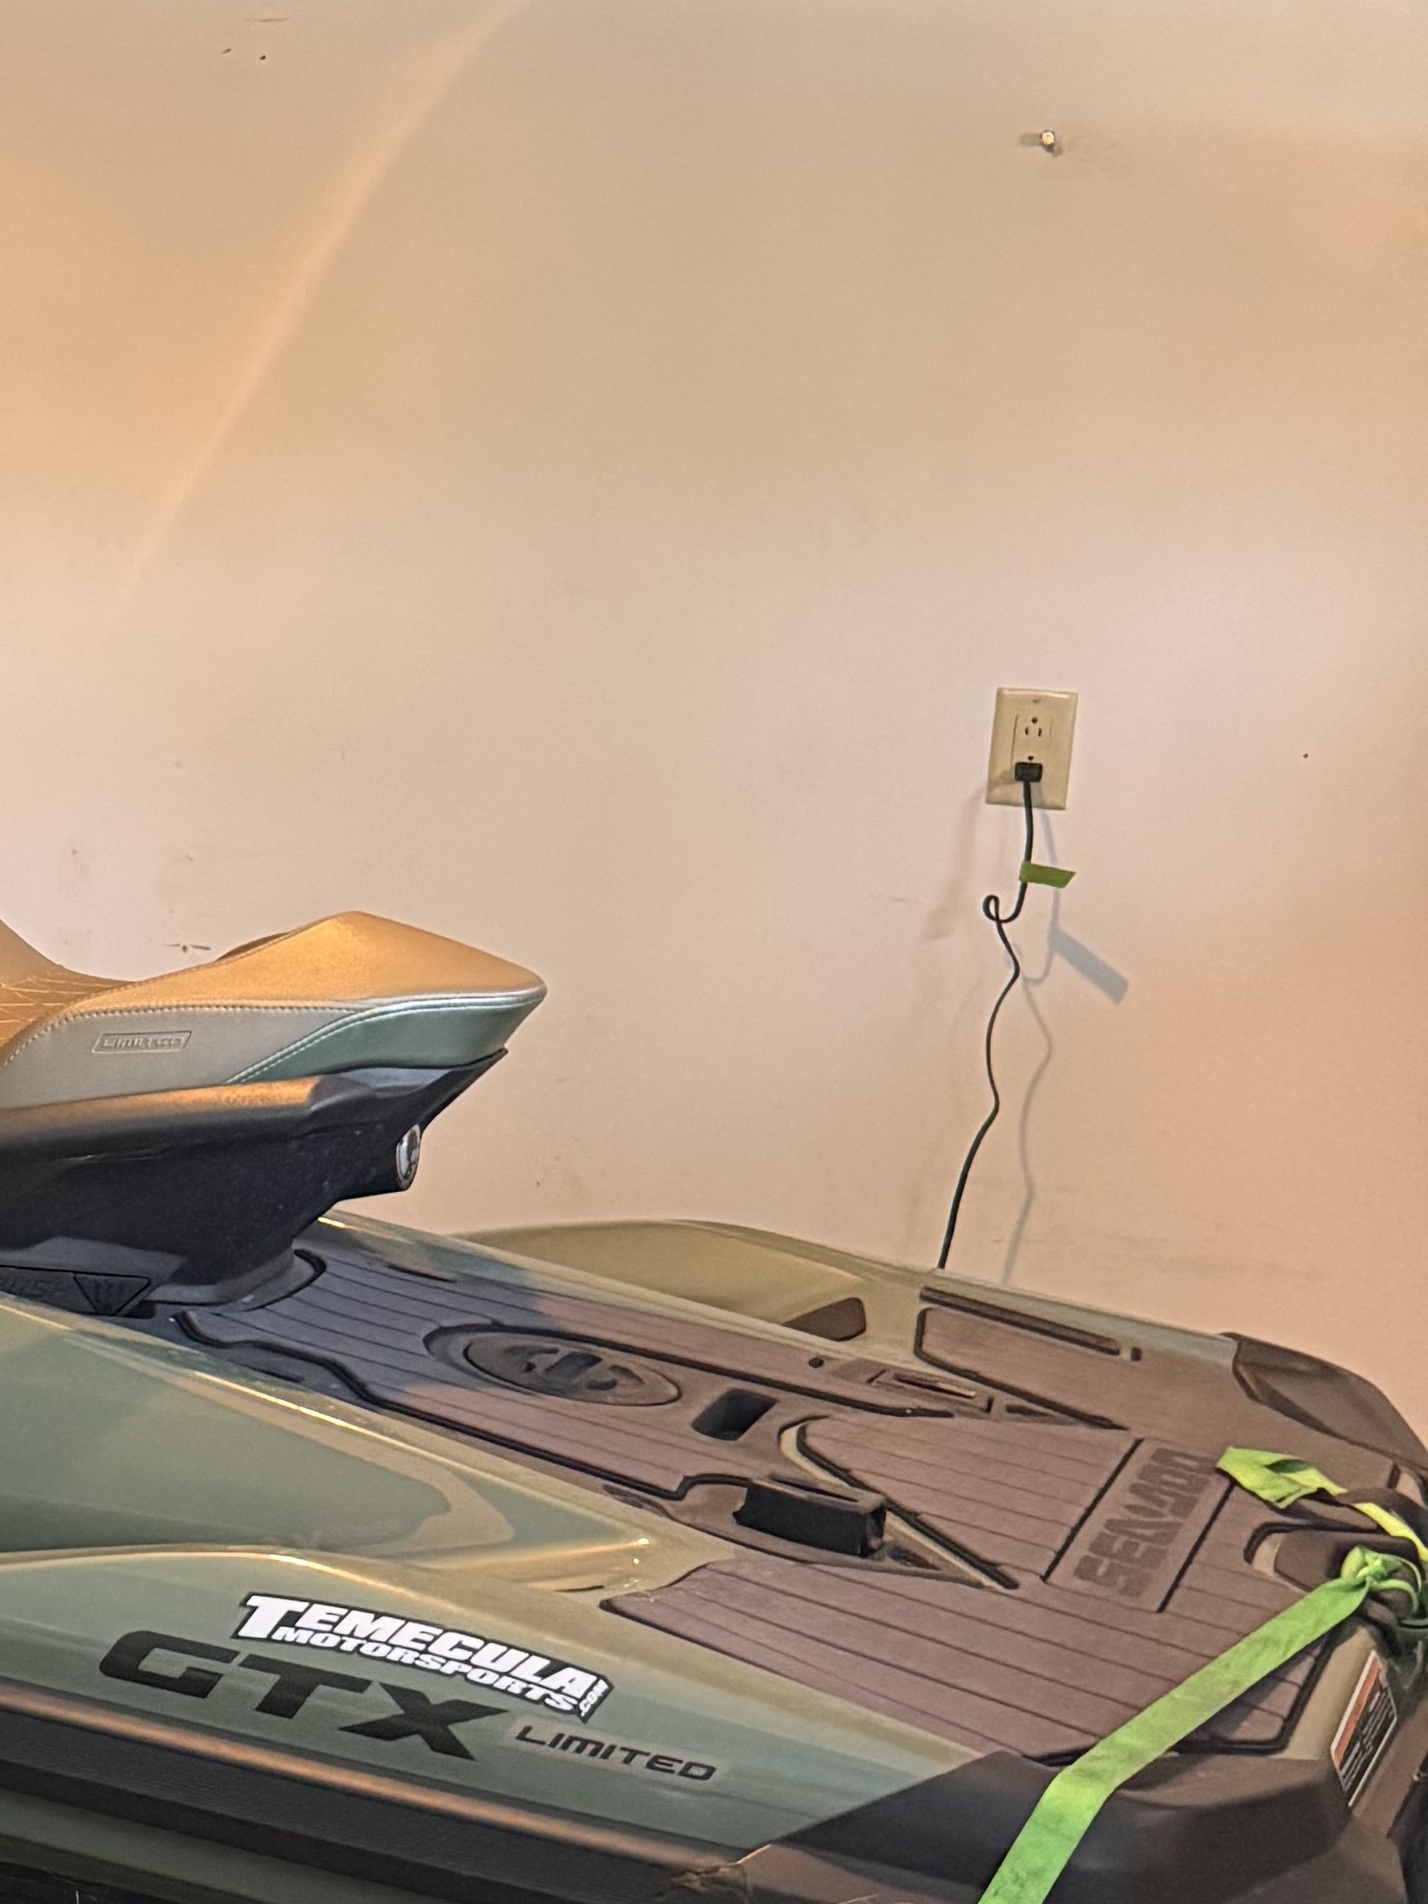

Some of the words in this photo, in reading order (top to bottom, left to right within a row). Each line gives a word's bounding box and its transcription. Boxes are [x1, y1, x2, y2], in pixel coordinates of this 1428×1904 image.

[238, 1595, 598, 1699] TEMECULA
[271, 1626, 578, 1711] MOTORSPORTS
[99, 1630, 509, 1761] GTX
[515, 1725, 717, 1781] LIMITED
